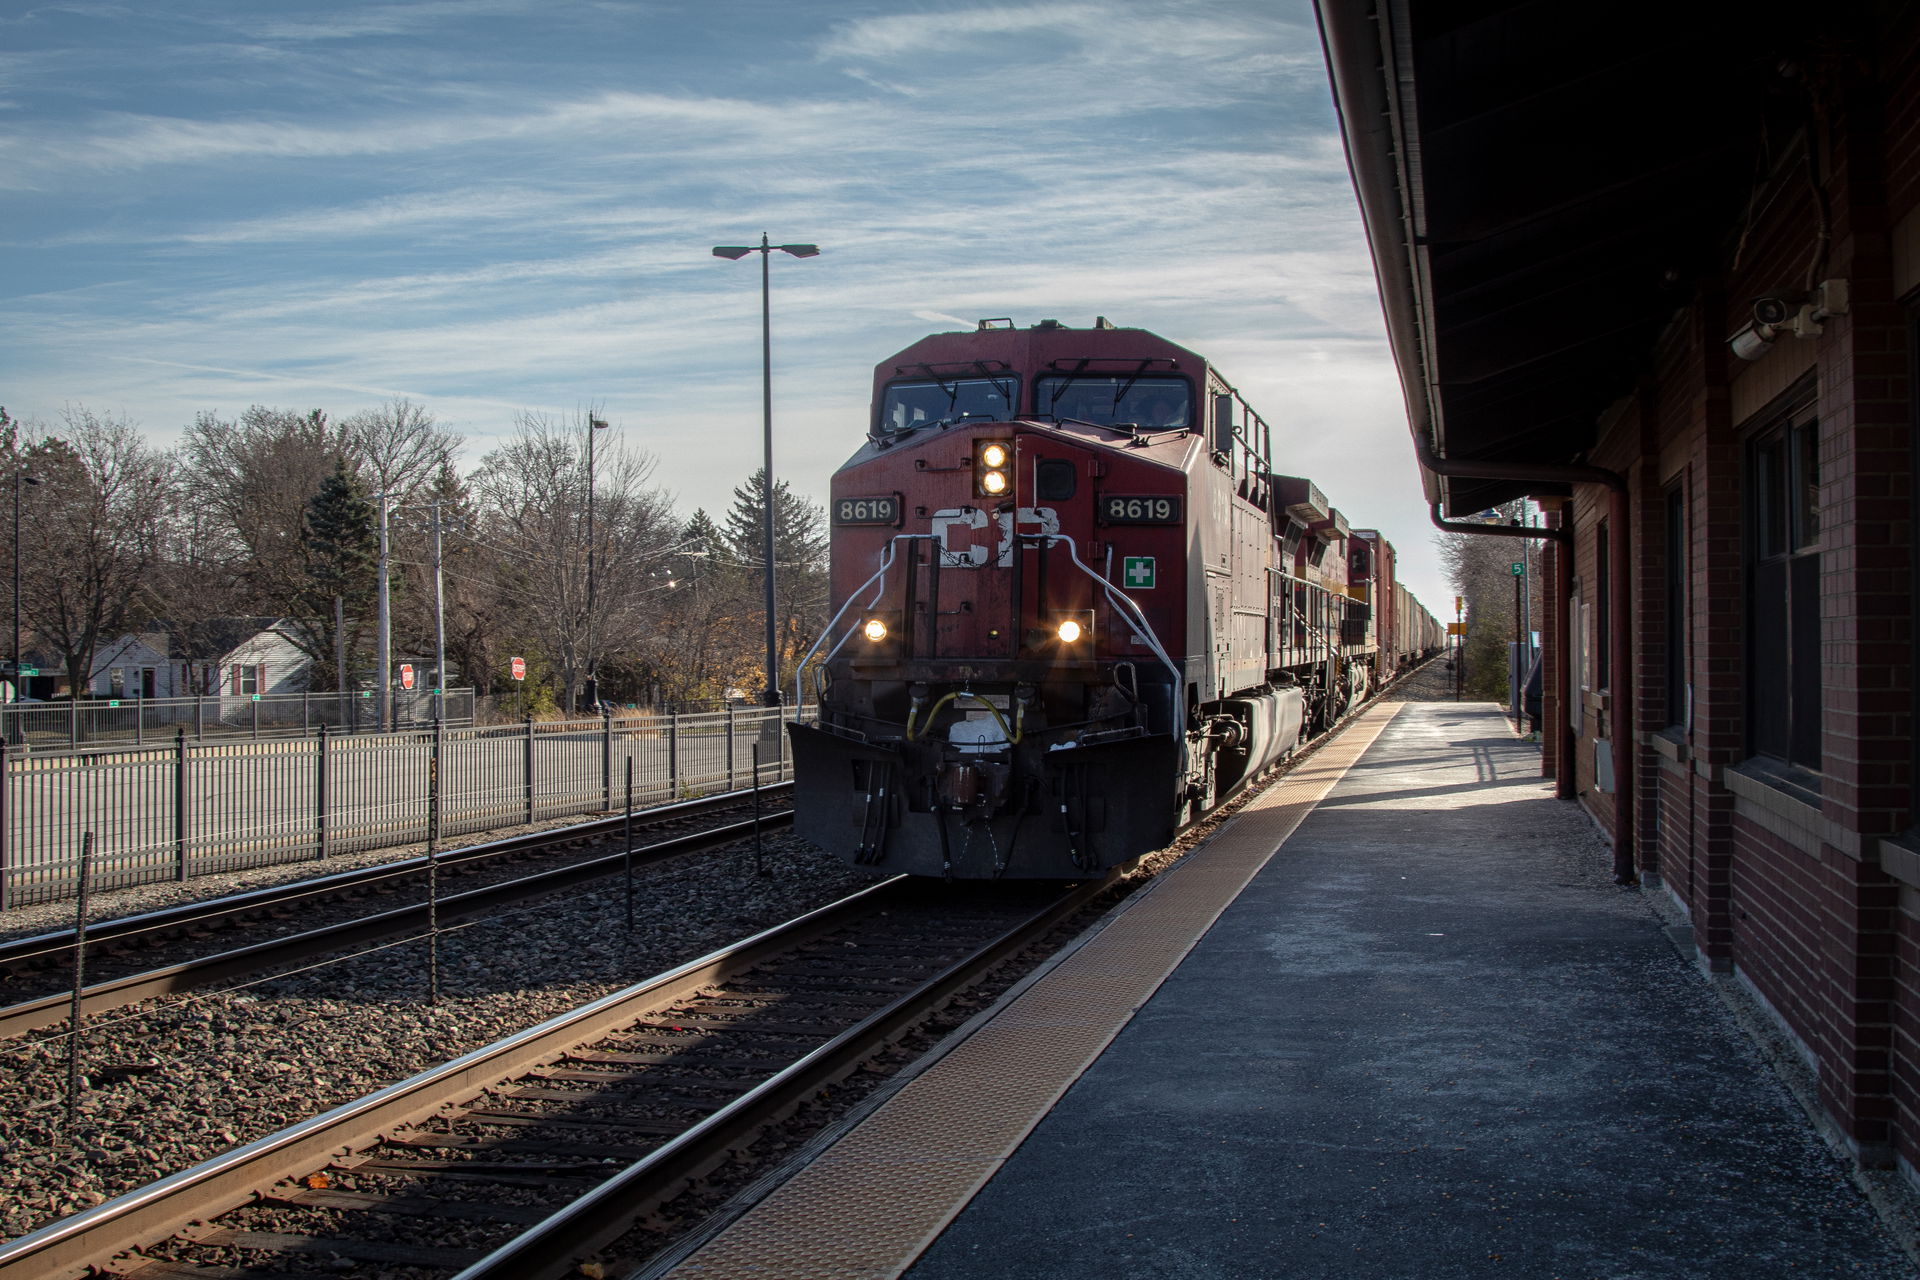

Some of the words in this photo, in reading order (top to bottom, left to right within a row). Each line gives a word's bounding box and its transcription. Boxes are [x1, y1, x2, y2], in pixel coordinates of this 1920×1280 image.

[841, 501, 891, 520] 8619
[1110, 499, 1170, 519] 8619
[932, 507, 1060, 568] CP
[1514, 564, 1522, 574] 5
